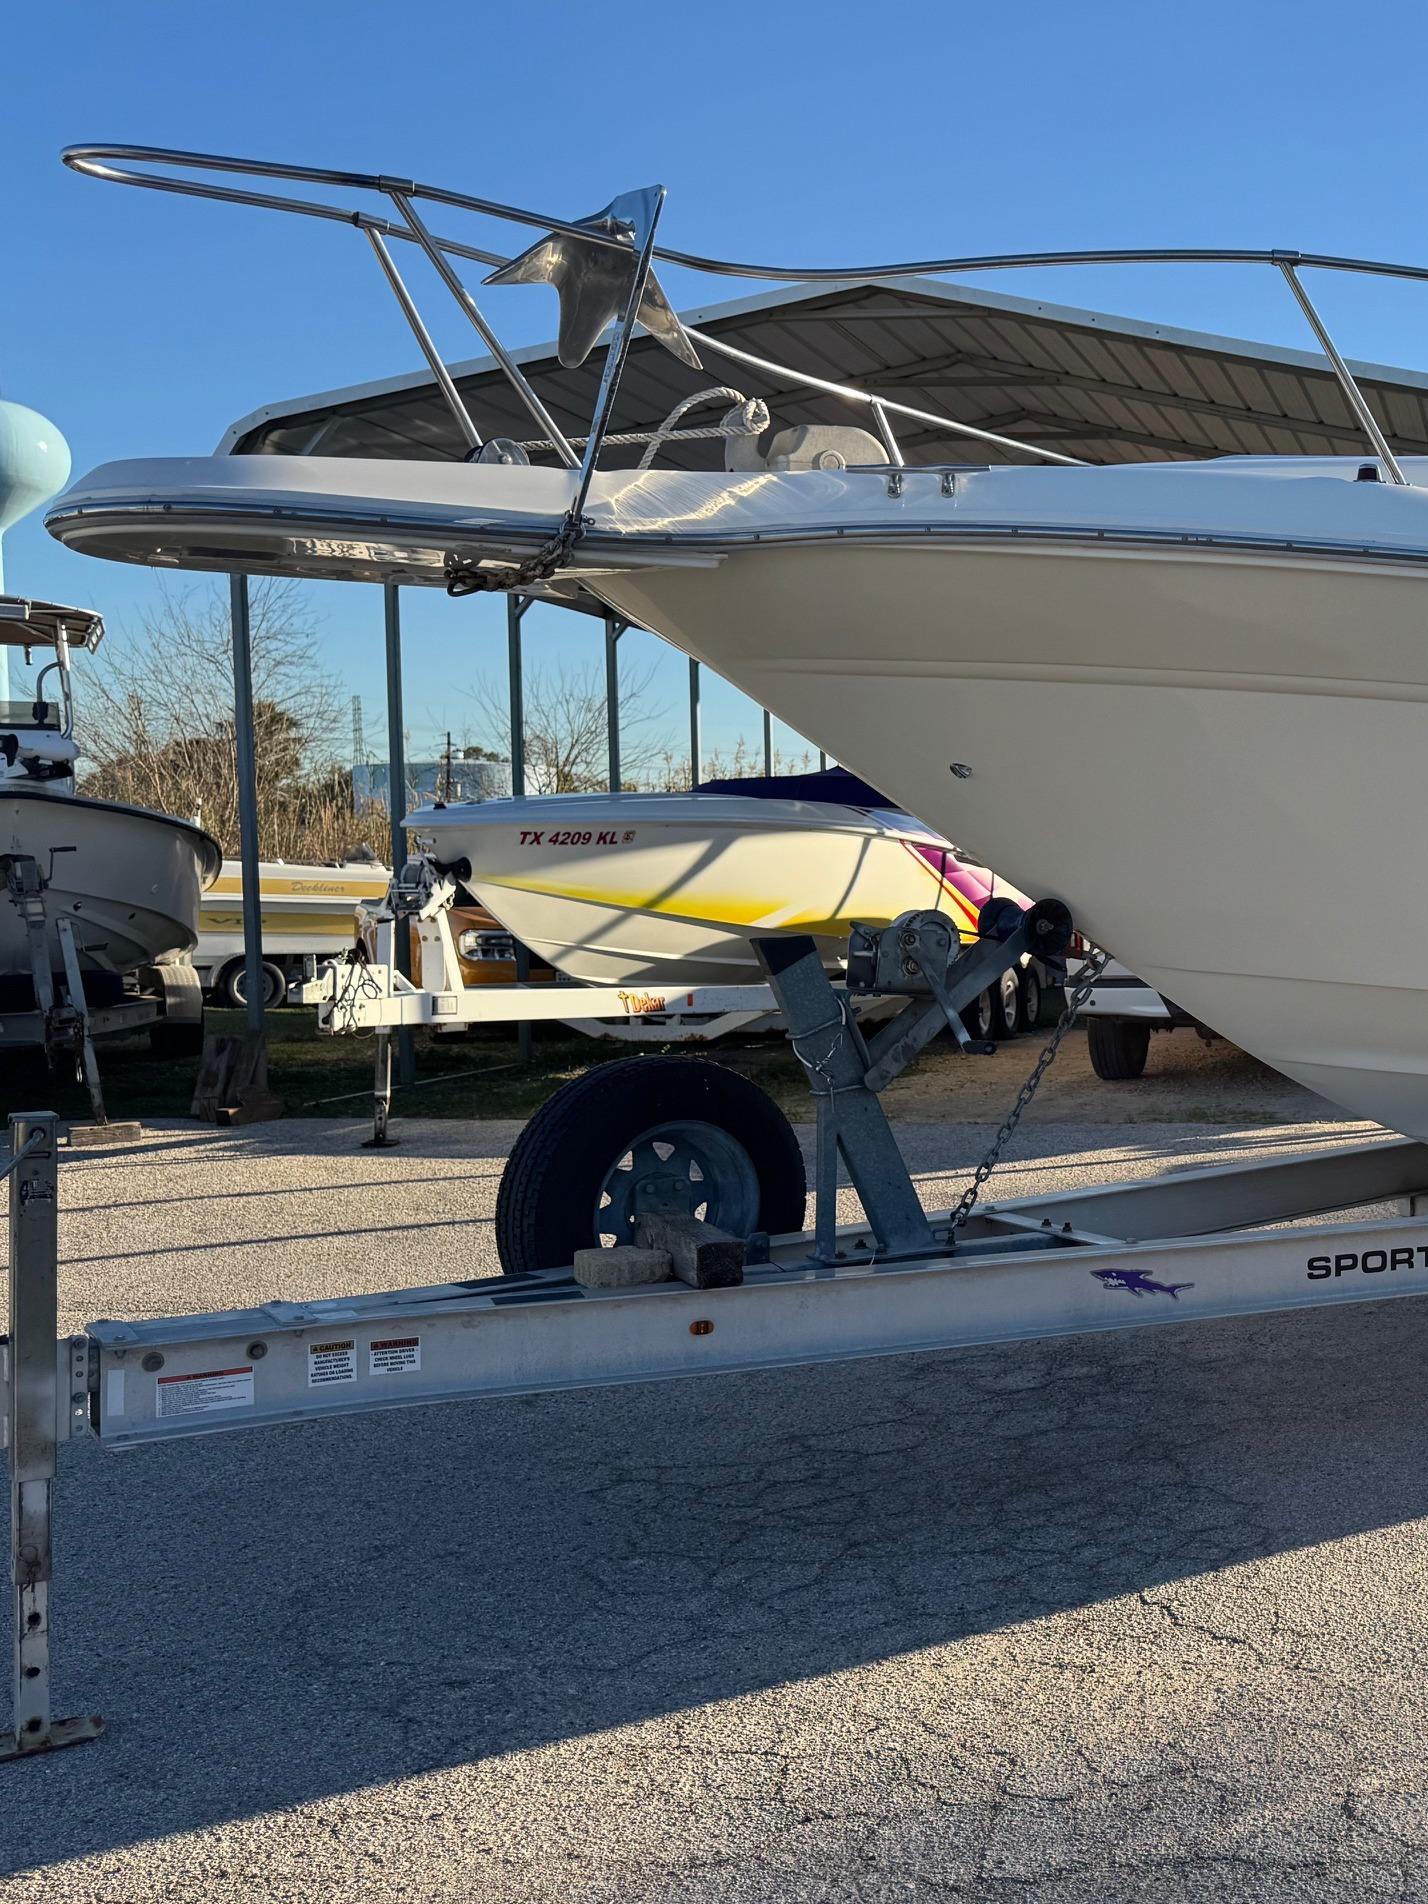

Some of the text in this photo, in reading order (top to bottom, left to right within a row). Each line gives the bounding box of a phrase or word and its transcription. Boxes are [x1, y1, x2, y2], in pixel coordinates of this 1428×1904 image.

[520, 831, 545, 846] TX
[548, 831, 592, 846] 4209
[596, 831, 618, 845] KL
[319, 1341, 351, 1350] CAUTION
